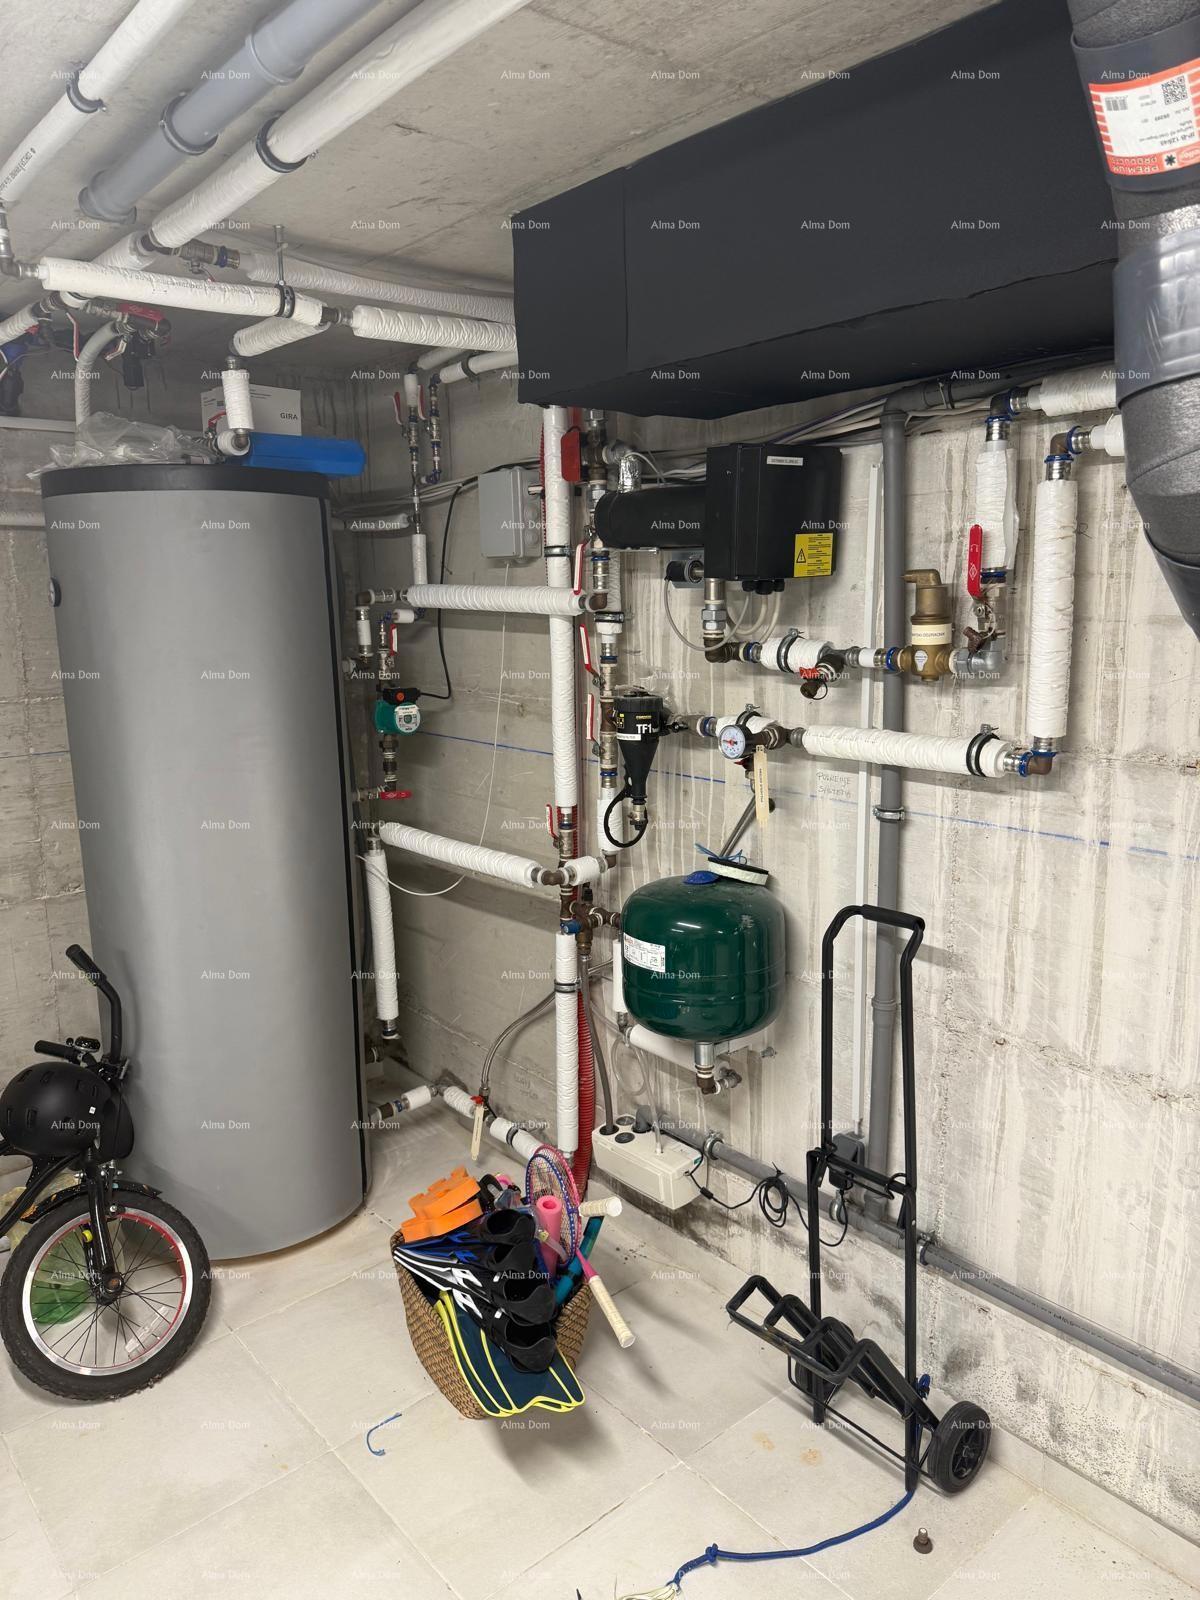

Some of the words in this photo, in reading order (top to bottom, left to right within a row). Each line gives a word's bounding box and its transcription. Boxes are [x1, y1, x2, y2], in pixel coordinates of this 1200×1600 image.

[1113, 165, 1160, 174] PREMIUM
[280, 412, 298, 421] GIRA
[636, 723, 652, 734] TF1
